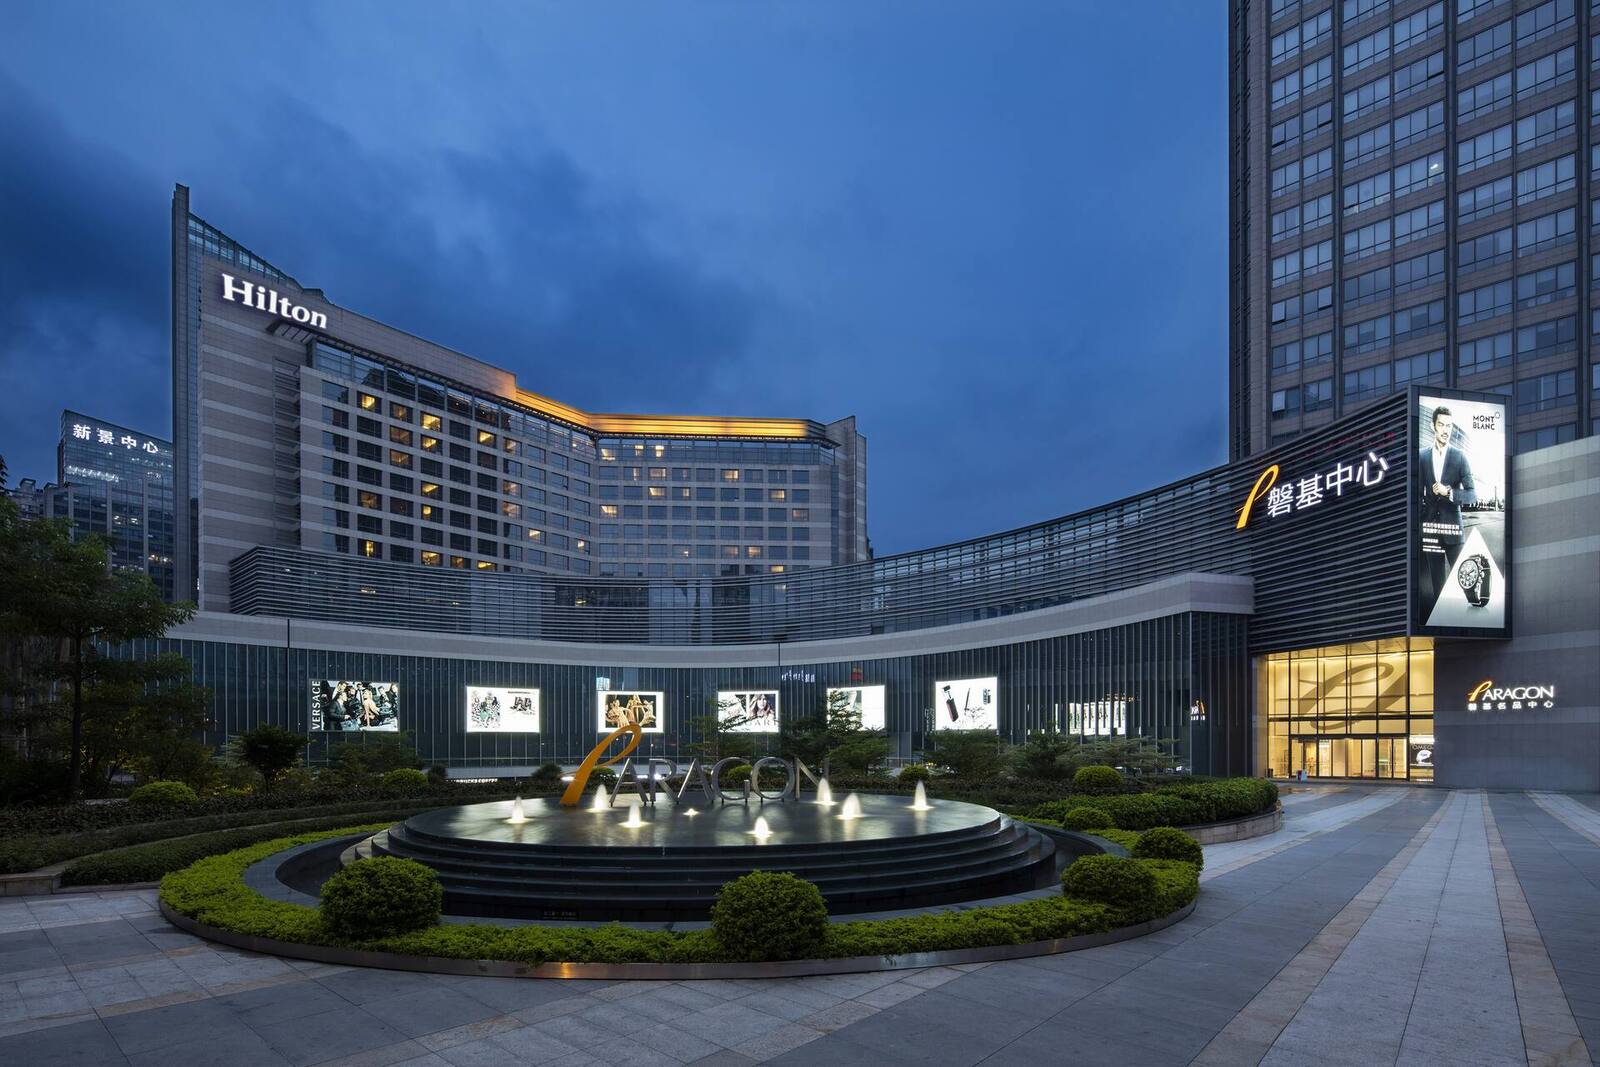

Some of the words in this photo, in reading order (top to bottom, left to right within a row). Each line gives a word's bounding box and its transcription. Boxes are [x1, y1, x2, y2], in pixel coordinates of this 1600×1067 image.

[222, 273, 328, 329] Hilton
[1473, 415, 1495, 423] MONT
[1473, 422, 1495, 430] BLANC
[73, 424, 159, 454] 新景中心
[1267, 451, 1389, 518] 磐基中心
[311, 680, 321, 730] VERSACE
[1468, 680, 1554, 702] PARAGON
